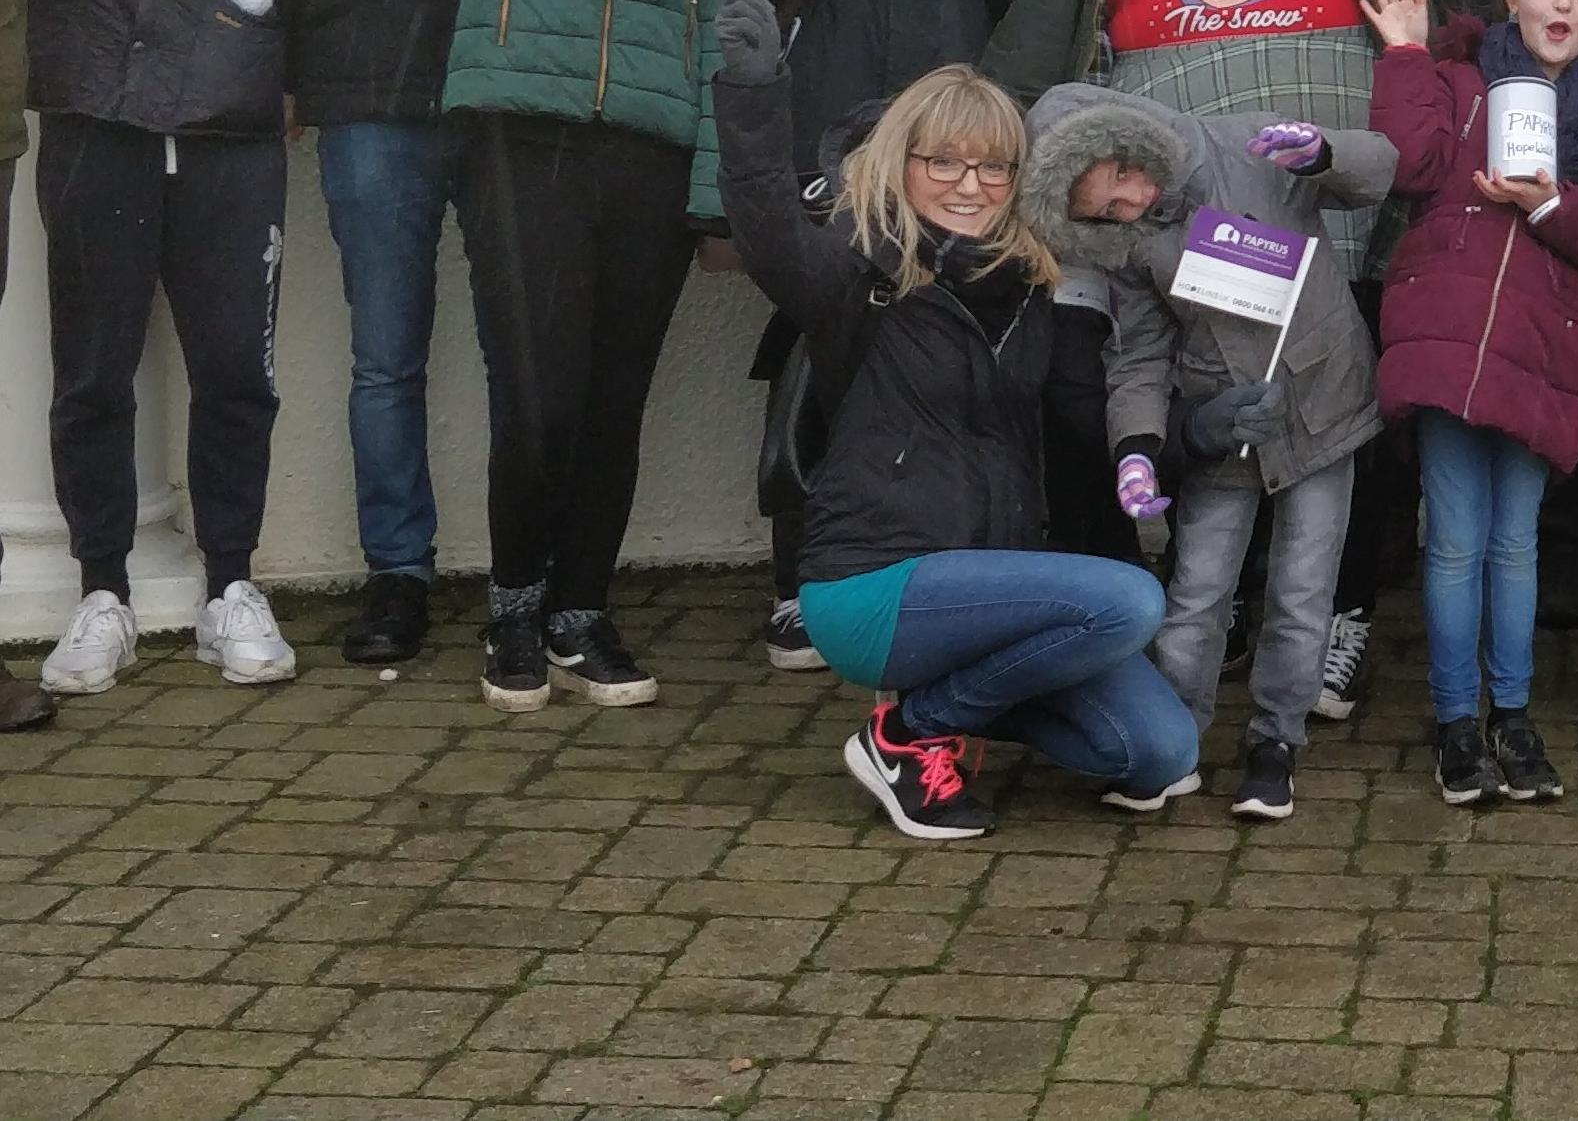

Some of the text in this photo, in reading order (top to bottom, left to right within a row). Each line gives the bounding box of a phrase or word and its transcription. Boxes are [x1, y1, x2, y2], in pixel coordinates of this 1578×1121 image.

[1164, 4, 1303, 38] The snow
[1242, 233, 1289, 255] PAPYRUS
[1231, 297, 1252, 309] 0800
[1252, 302, 1267, 313] 068
